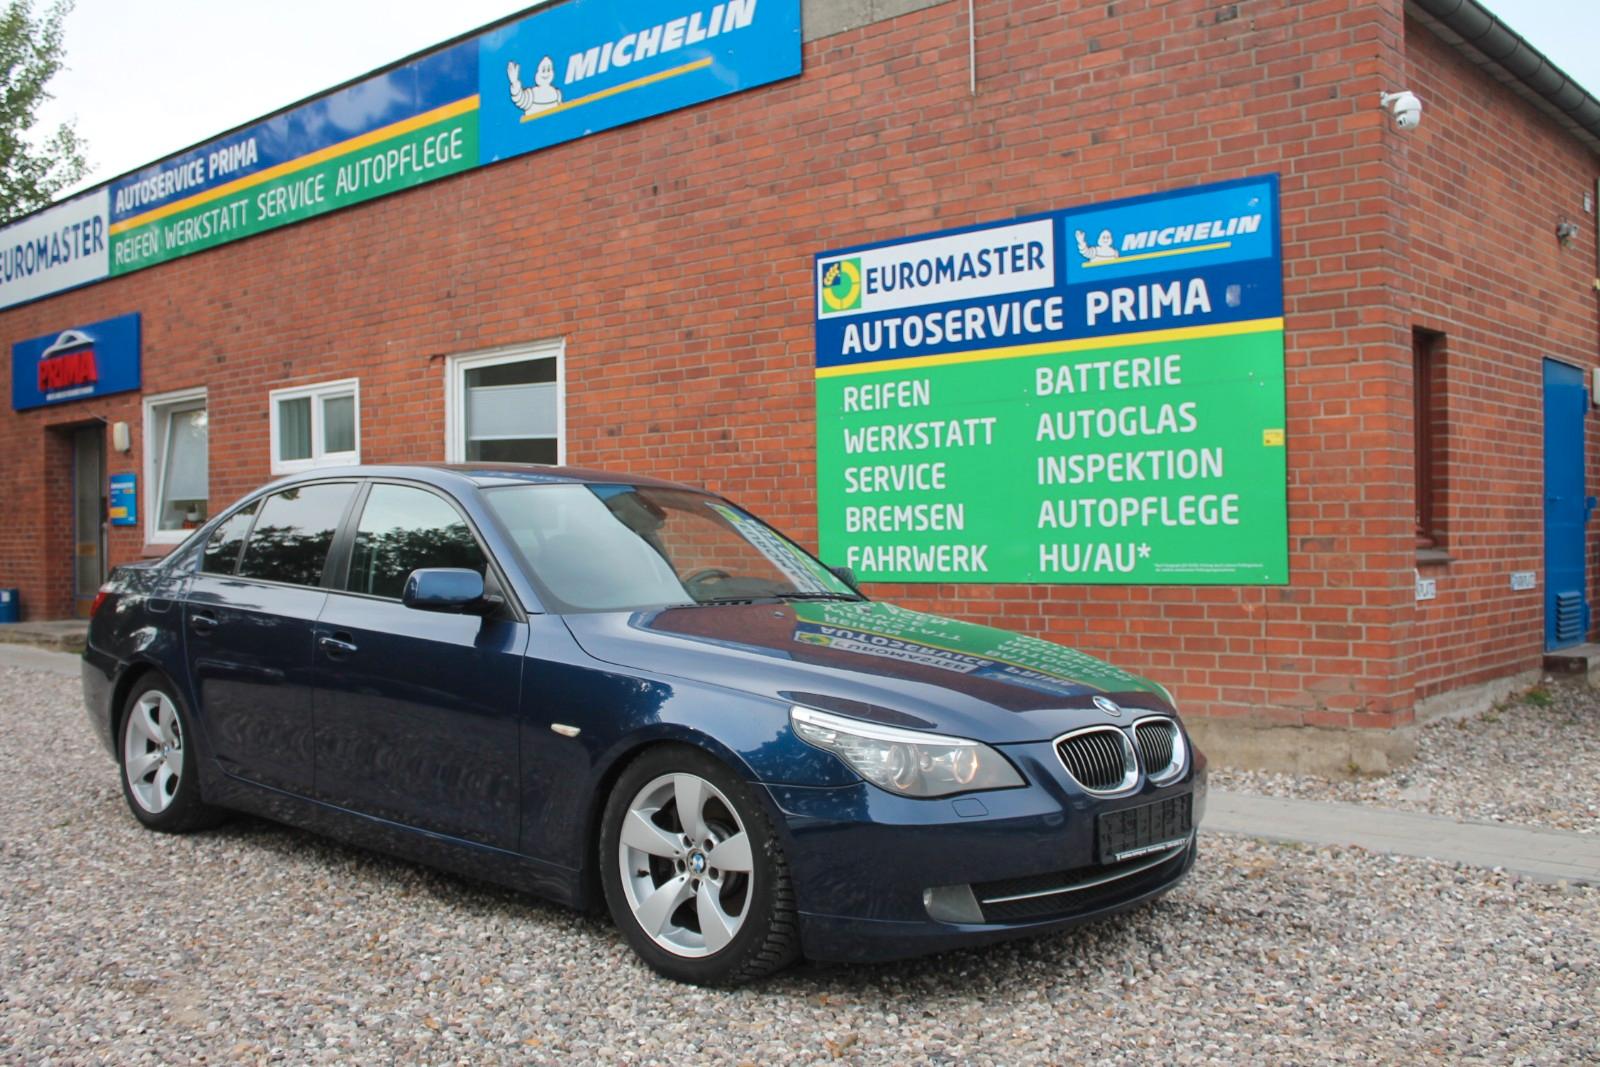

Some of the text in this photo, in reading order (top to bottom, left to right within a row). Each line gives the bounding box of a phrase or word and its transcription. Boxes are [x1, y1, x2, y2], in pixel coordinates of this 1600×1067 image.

[564, 0, 757, 85] MICHELIN
[116, 137, 258, 214] AUTOSERVICE PRIMA
[115, 127, 464, 265] REIFEN WERKSTATT SERVICE AUTOPFLEGE
[1121, 214, 1261, 252] MICHELIN
[866, 240, 1046, 296] EUROMASTER
[841, 278, 1212, 355] AUTOSERVICE PRIMA
[38, 350, 97, 392] PRIMA
[1035, 354, 1182, 397] BATTERIE
[843, 379, 931, 413] REIFEN
[844, 417, 997, 455] WERKSTATT
[1036, 402, 1198, 442] AUTOGLAS
[845, 462, 946, 494] SERVICE
[1037, 448, 1224, 485] INSPEKTION
[846, 503, 964, 533] BREMSEN
[1038, 494, 1240, 529] AUTOPFLEGE
[846, 545, 989, 573] FAHRWERK
